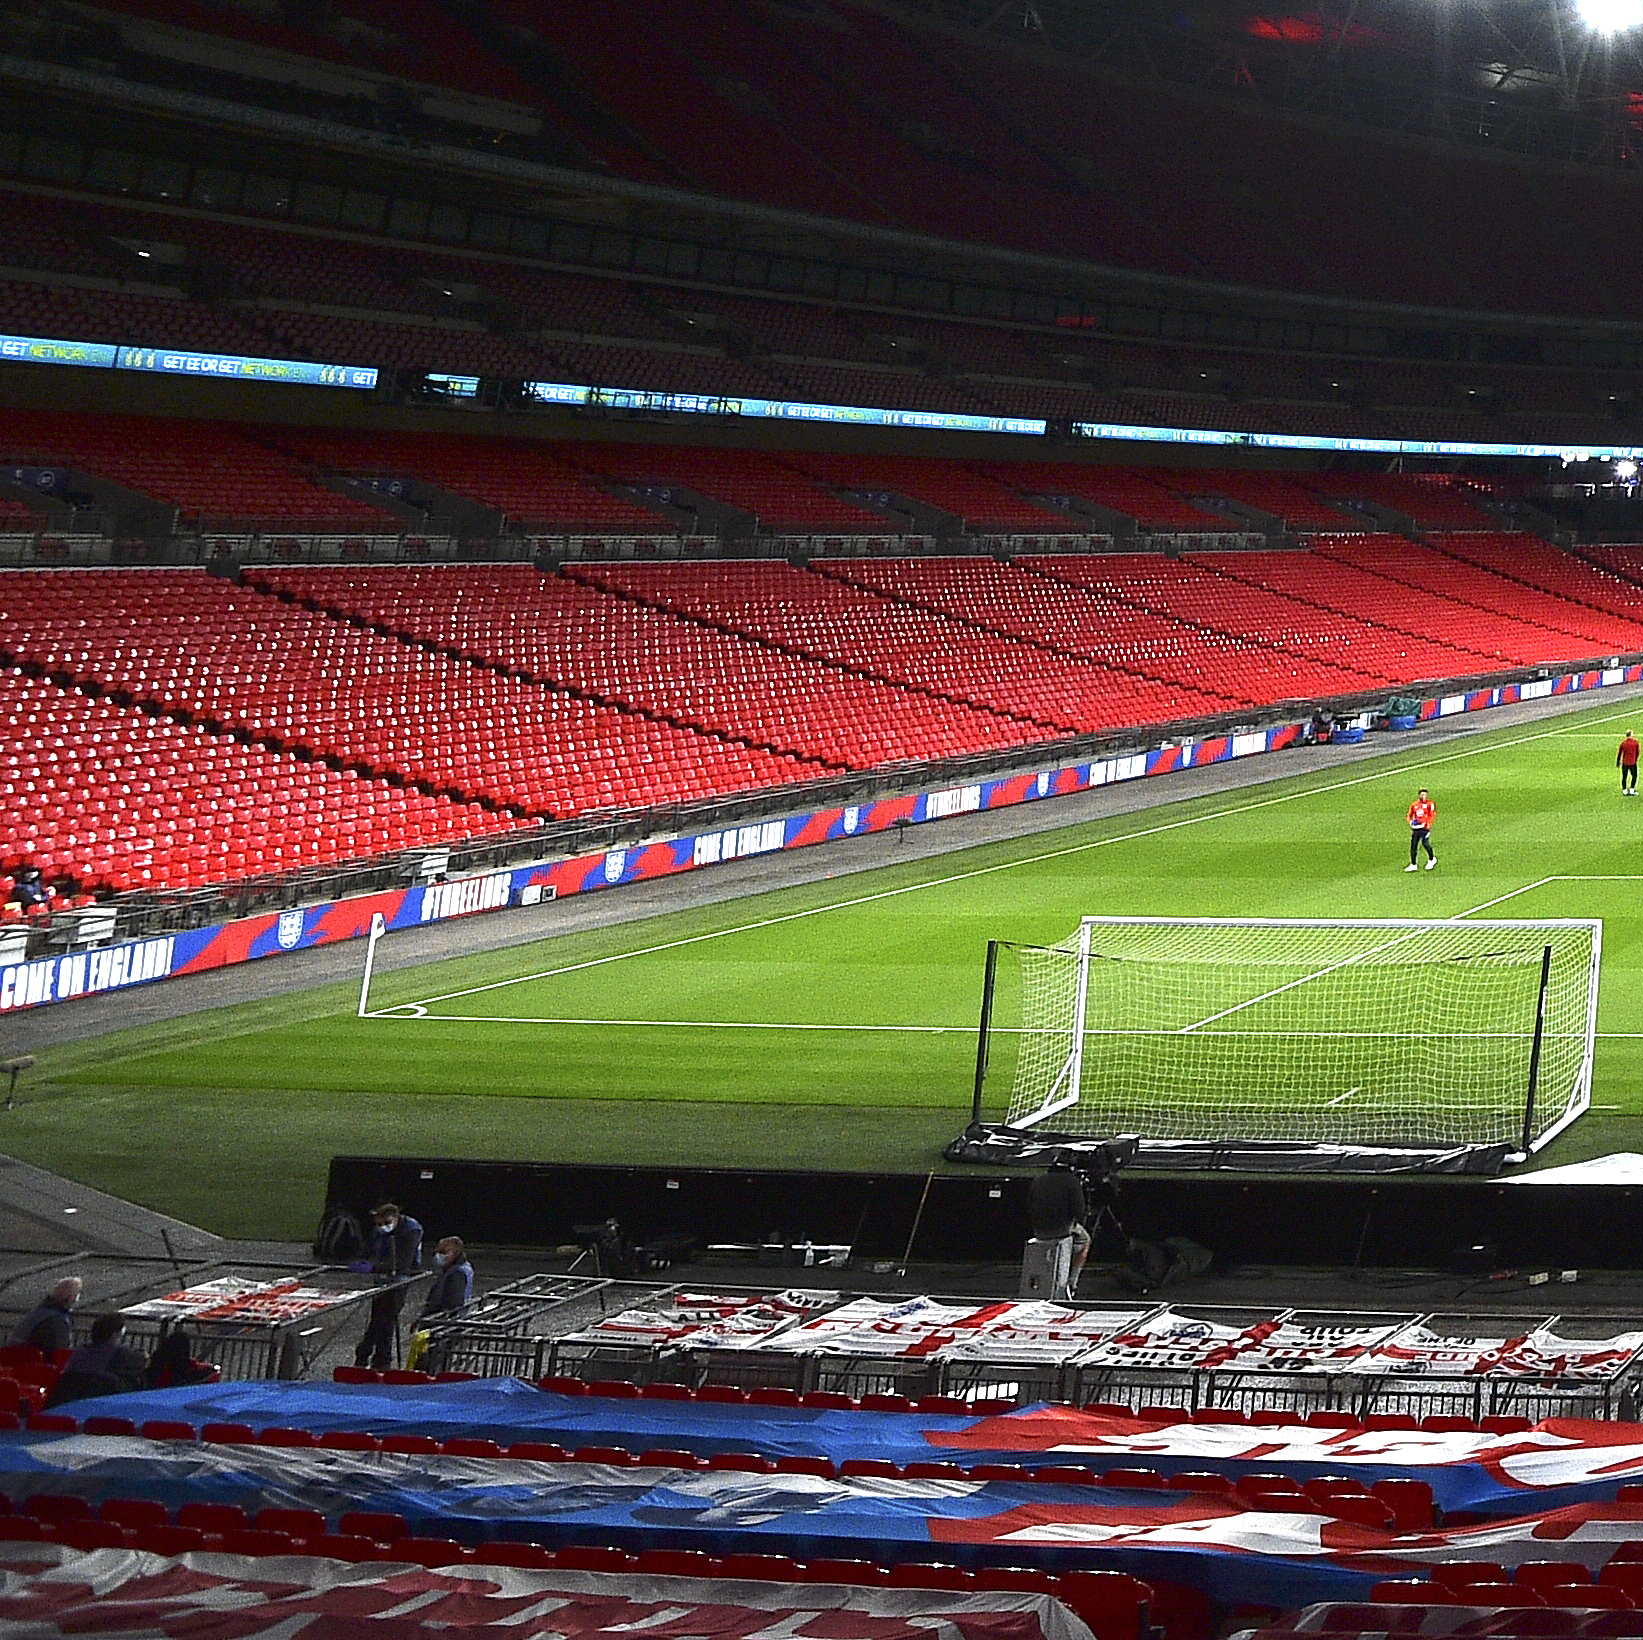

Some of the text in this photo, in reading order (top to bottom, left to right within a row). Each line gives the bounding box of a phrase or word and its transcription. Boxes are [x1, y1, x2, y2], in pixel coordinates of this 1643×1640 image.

[2, 341, 29, 357] GET
[164, 355, 185, 369] GET
[219, 360, 241, 374] GET
[420, 873, 512, 922] #THREELIONS
[1, 936, 175, 1009] COME ON ENGLAND!
